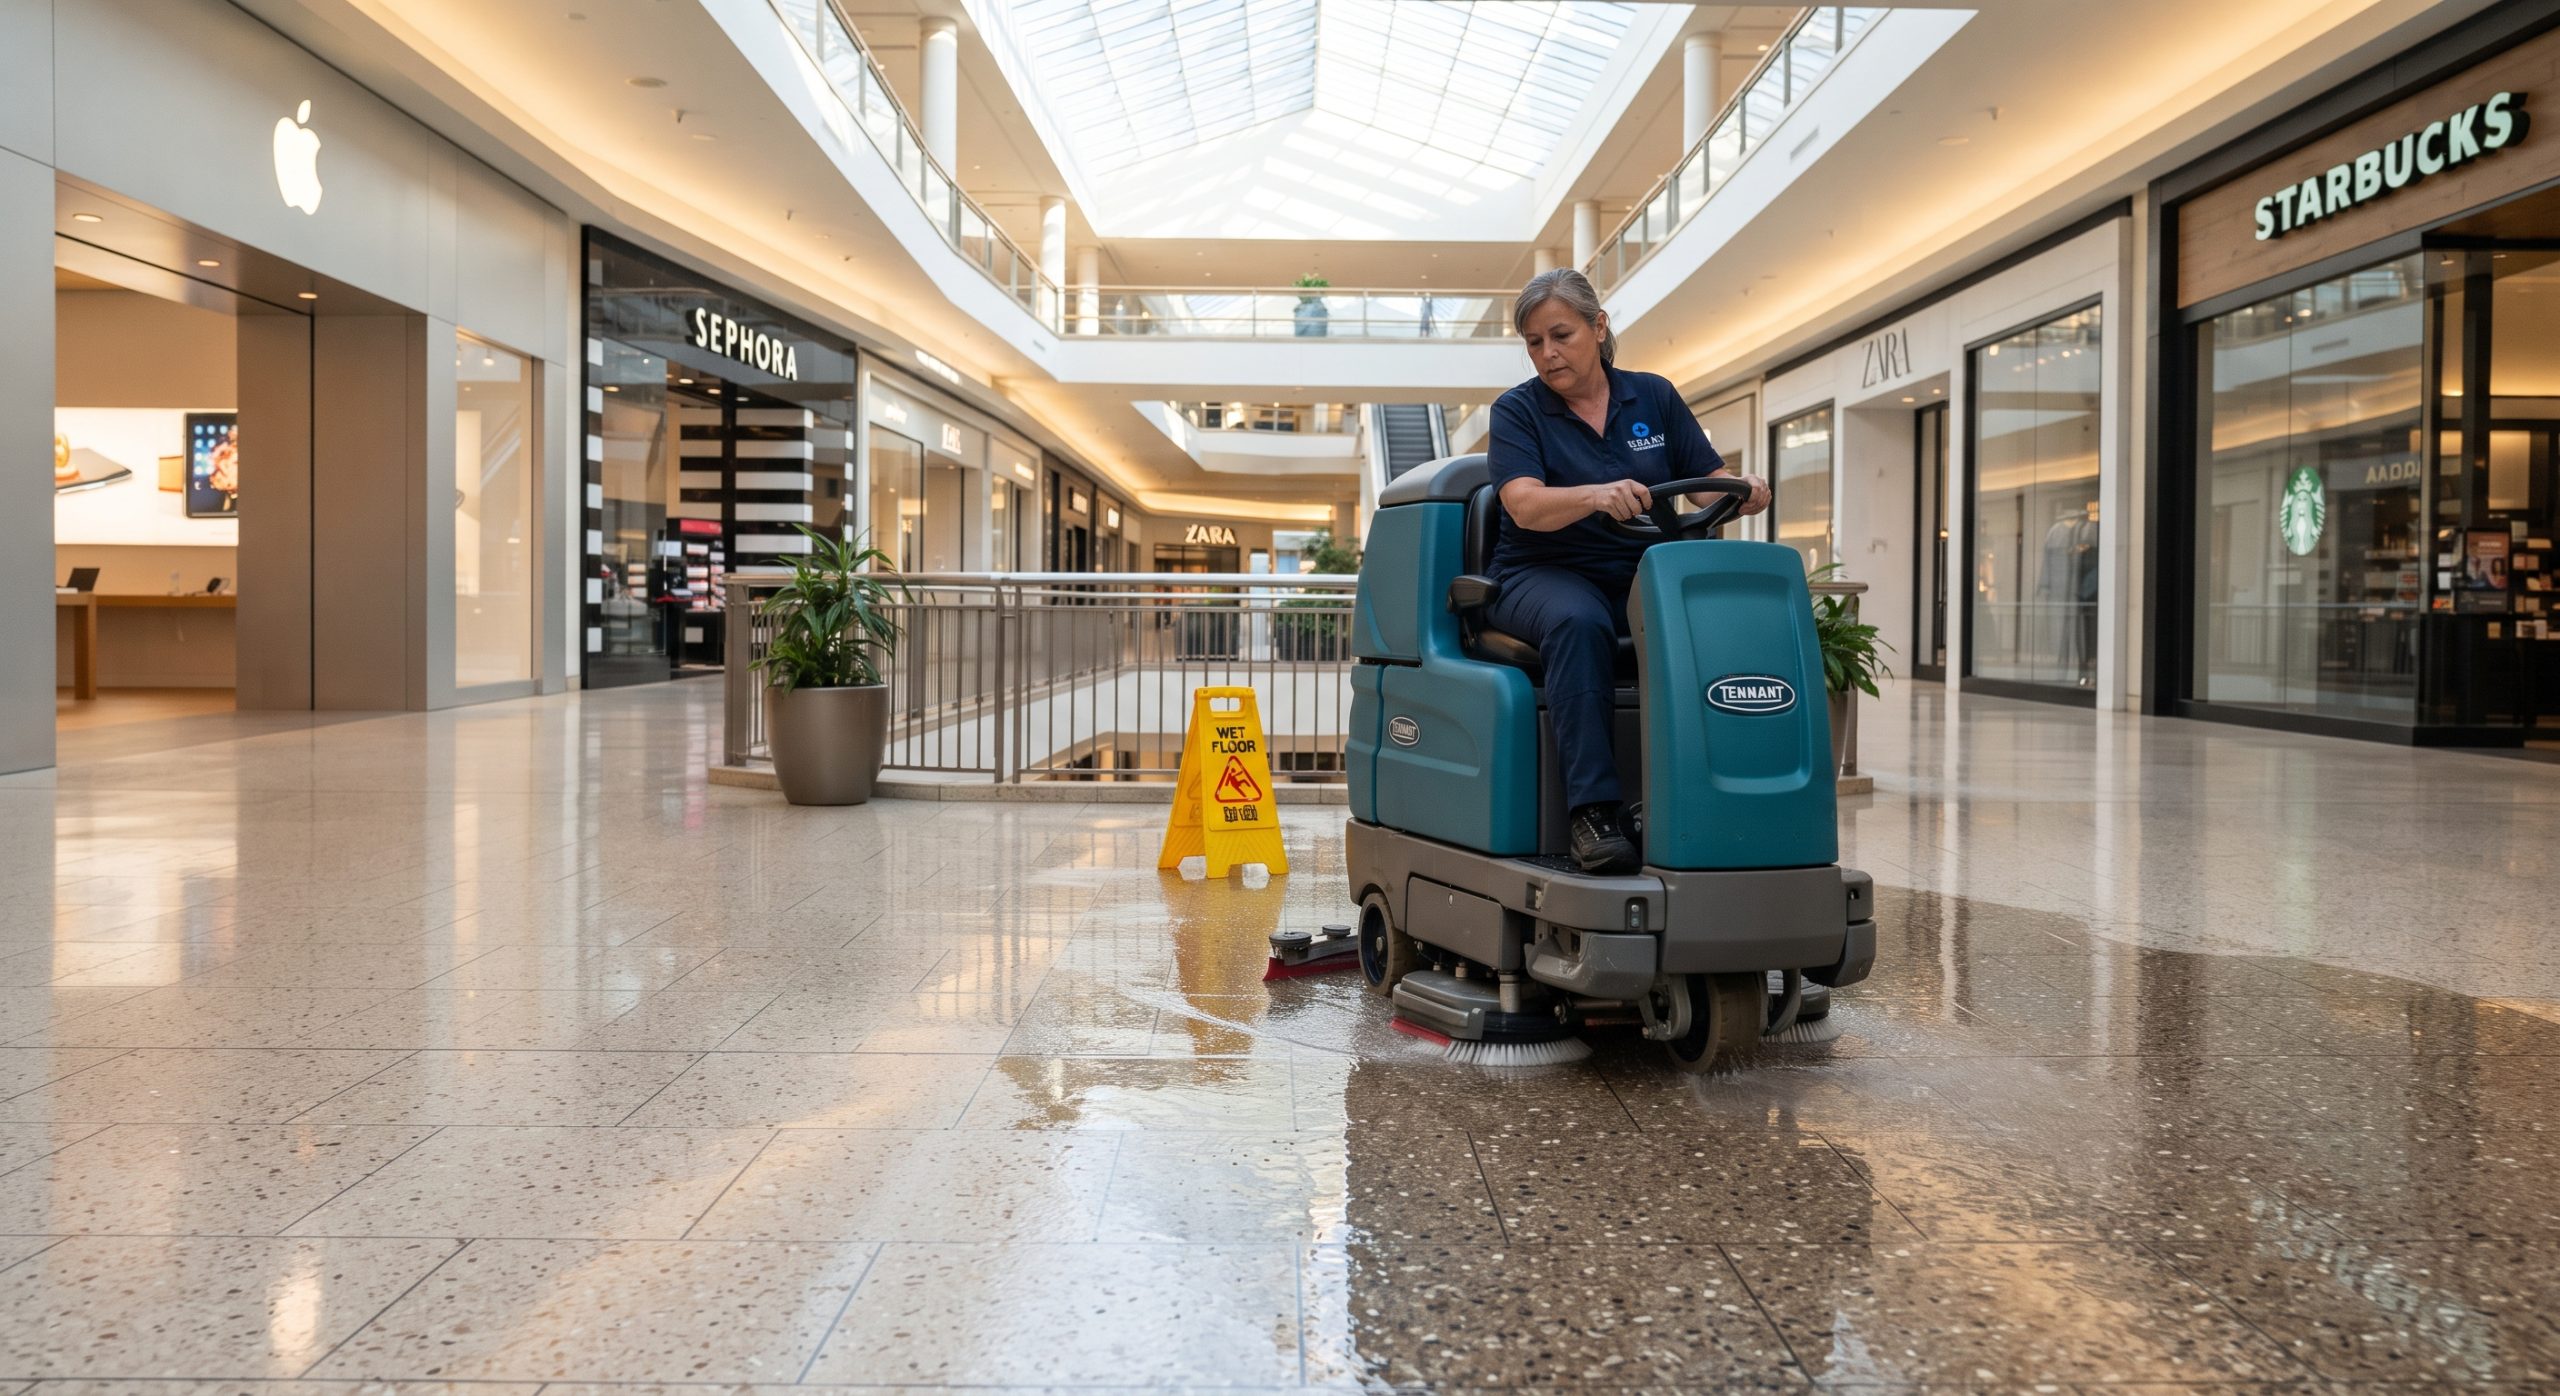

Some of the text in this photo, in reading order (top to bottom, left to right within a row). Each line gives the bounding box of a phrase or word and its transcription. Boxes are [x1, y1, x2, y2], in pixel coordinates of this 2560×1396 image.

[2255, 92, 2513, 241] STARBUCKS
[695, 307, 798, 381] SEPHORA
[1862, 327, 1912, 389] ZARA
[1185, 524, 1236, 545] ZARA
[1719, 686, 1784, 703] TENNANT
[1216, 726, 1245, 739] WET
[1212, 740, 1256, 753] FLOOR
